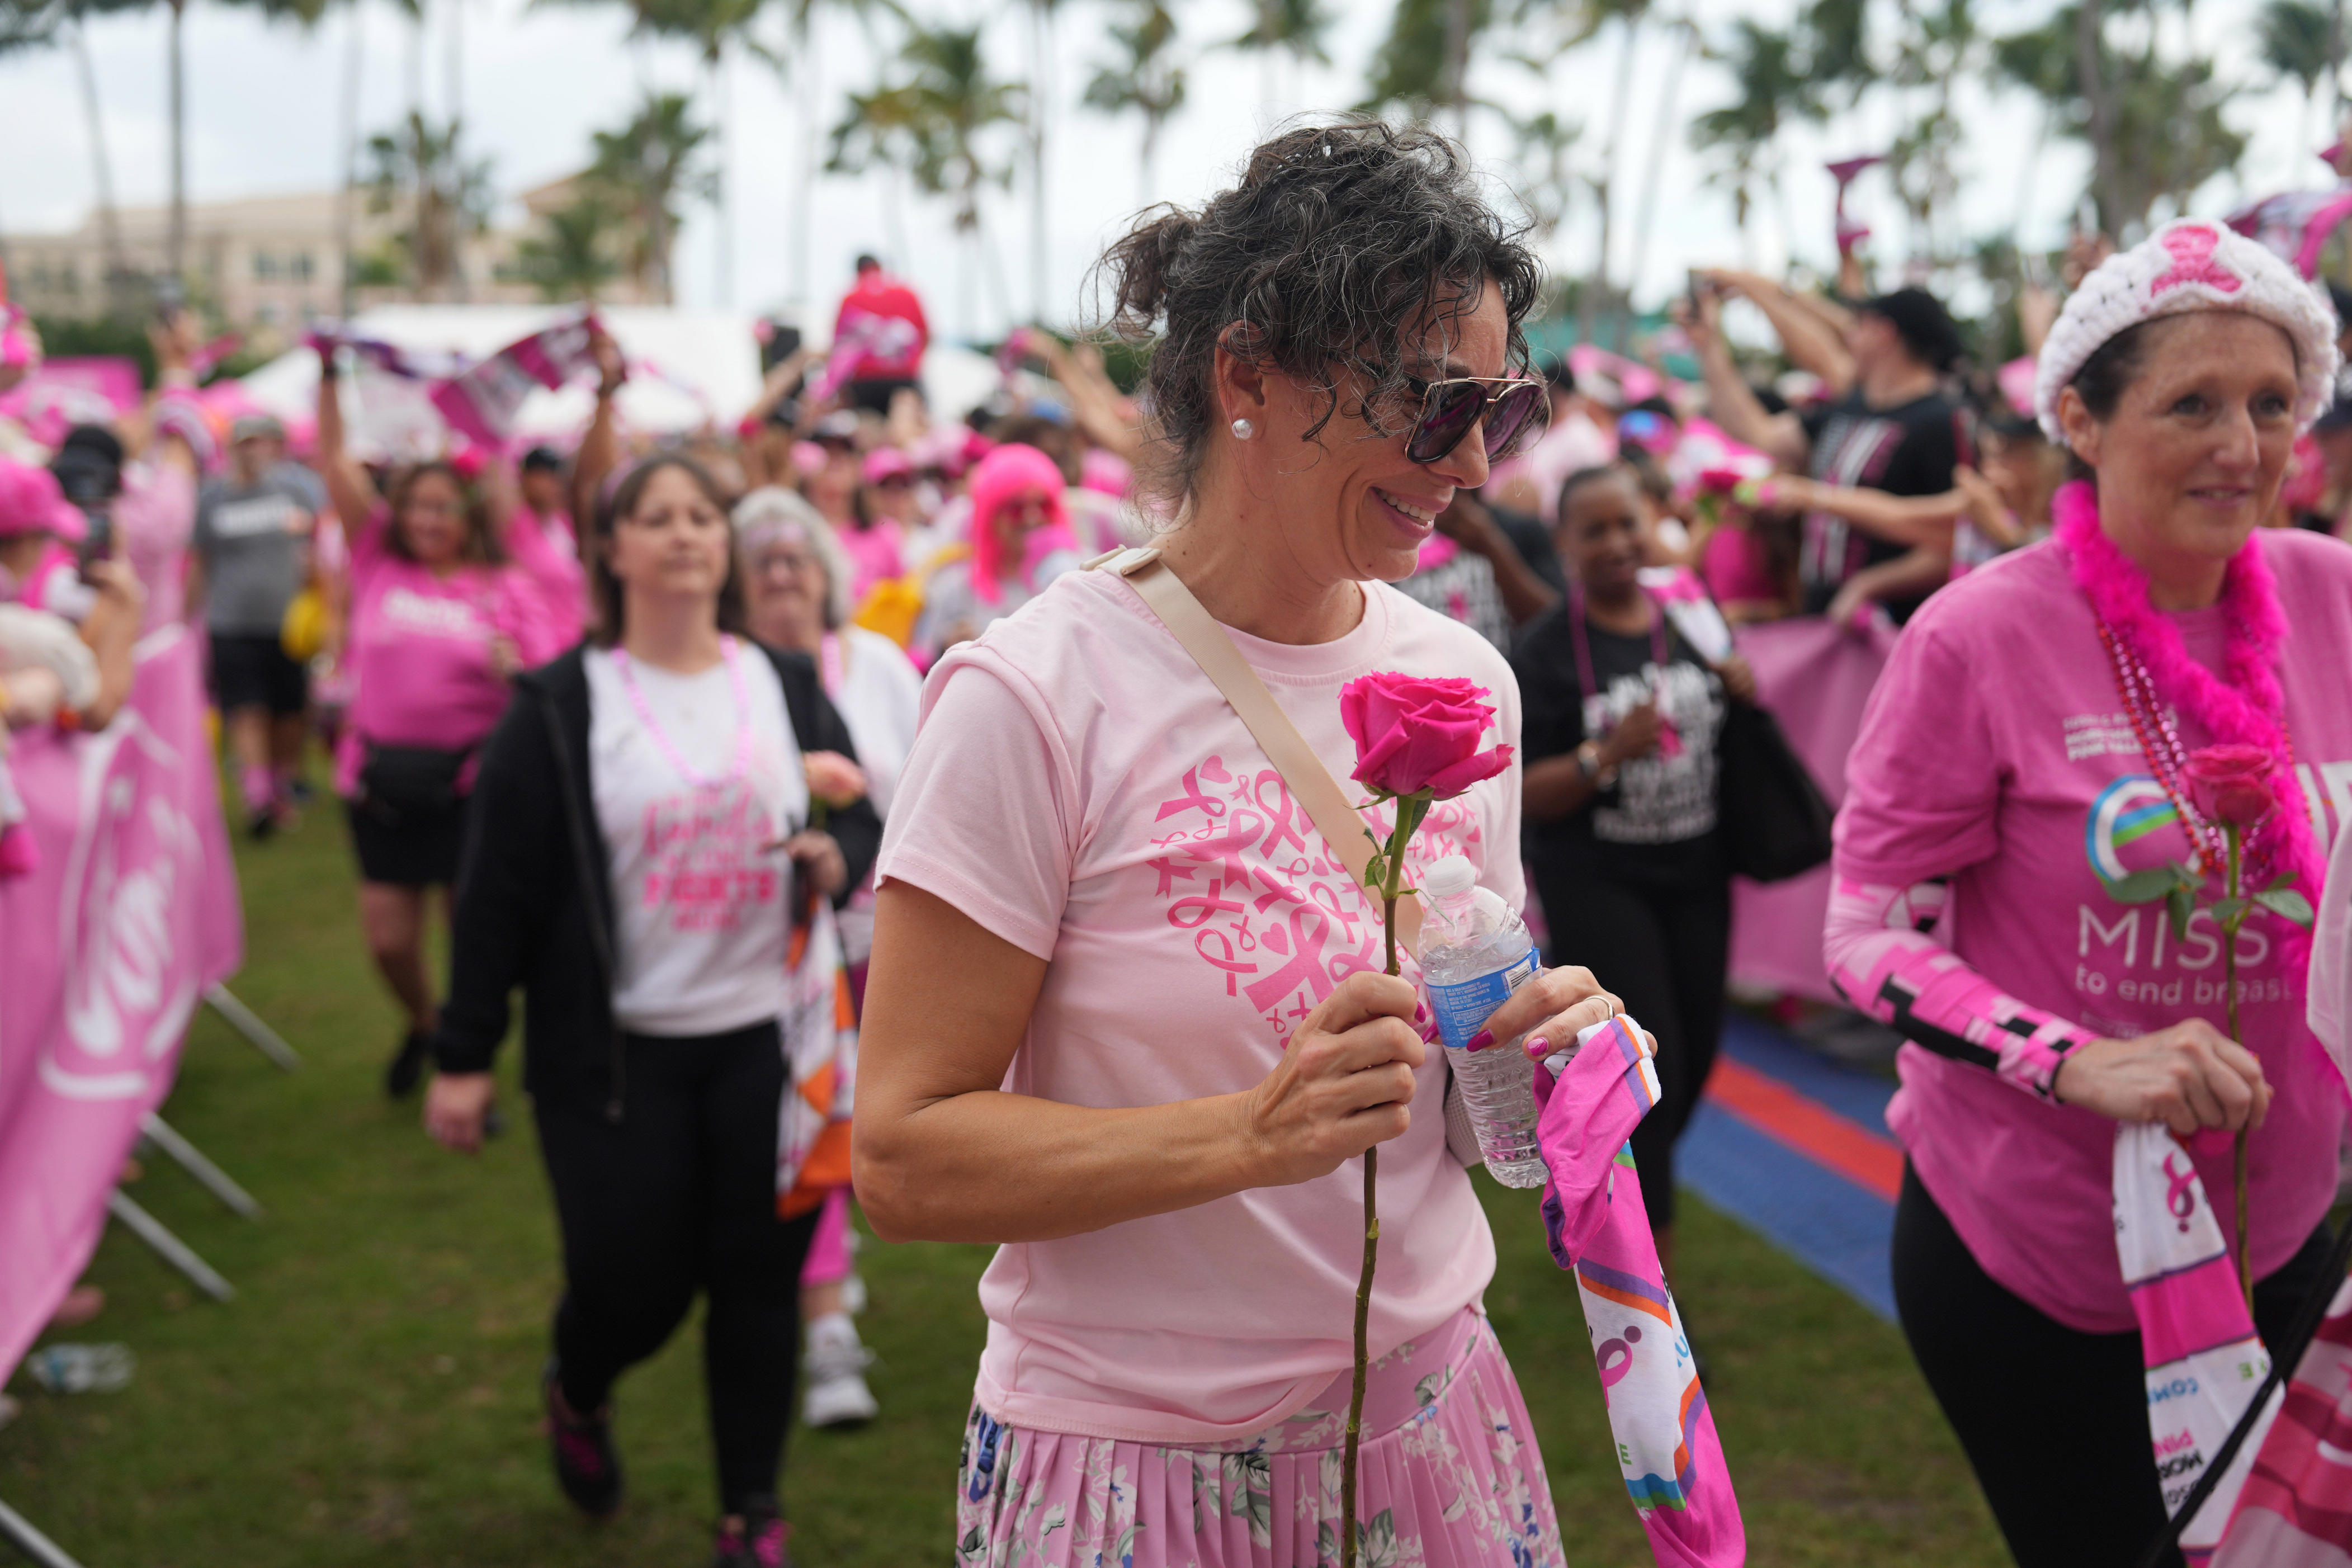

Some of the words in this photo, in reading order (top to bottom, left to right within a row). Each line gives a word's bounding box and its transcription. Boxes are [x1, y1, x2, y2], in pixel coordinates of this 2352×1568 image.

[2078, 903, 2269, 969] MISS
[2075, 962, 2108, 995] to
[2117, 976, 2182, 1006] end
